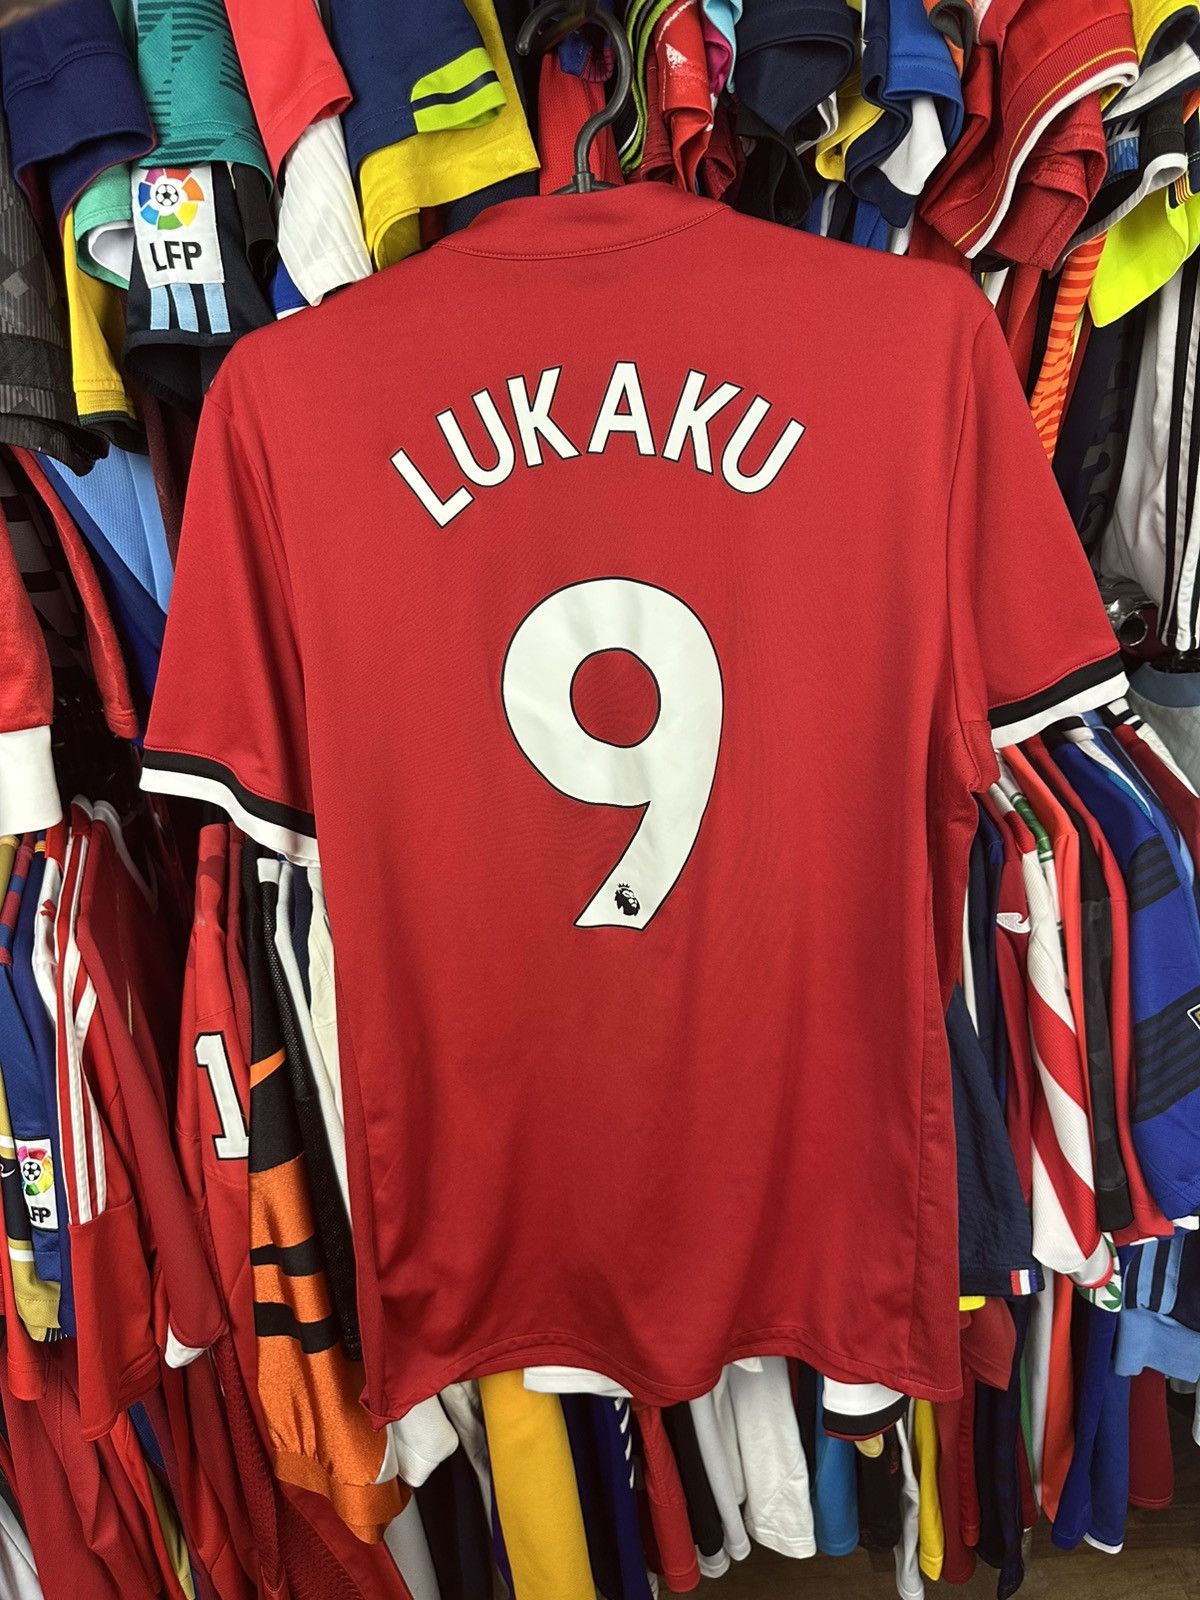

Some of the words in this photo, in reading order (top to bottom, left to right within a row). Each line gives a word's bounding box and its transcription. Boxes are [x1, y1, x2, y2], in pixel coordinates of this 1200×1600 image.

[149, 240, 202, 272] LFP
[390, 360, 806, 528] LUKAKU
[501, 576, 724, 931] 9
[194, 1030, 250, 1161] 1
